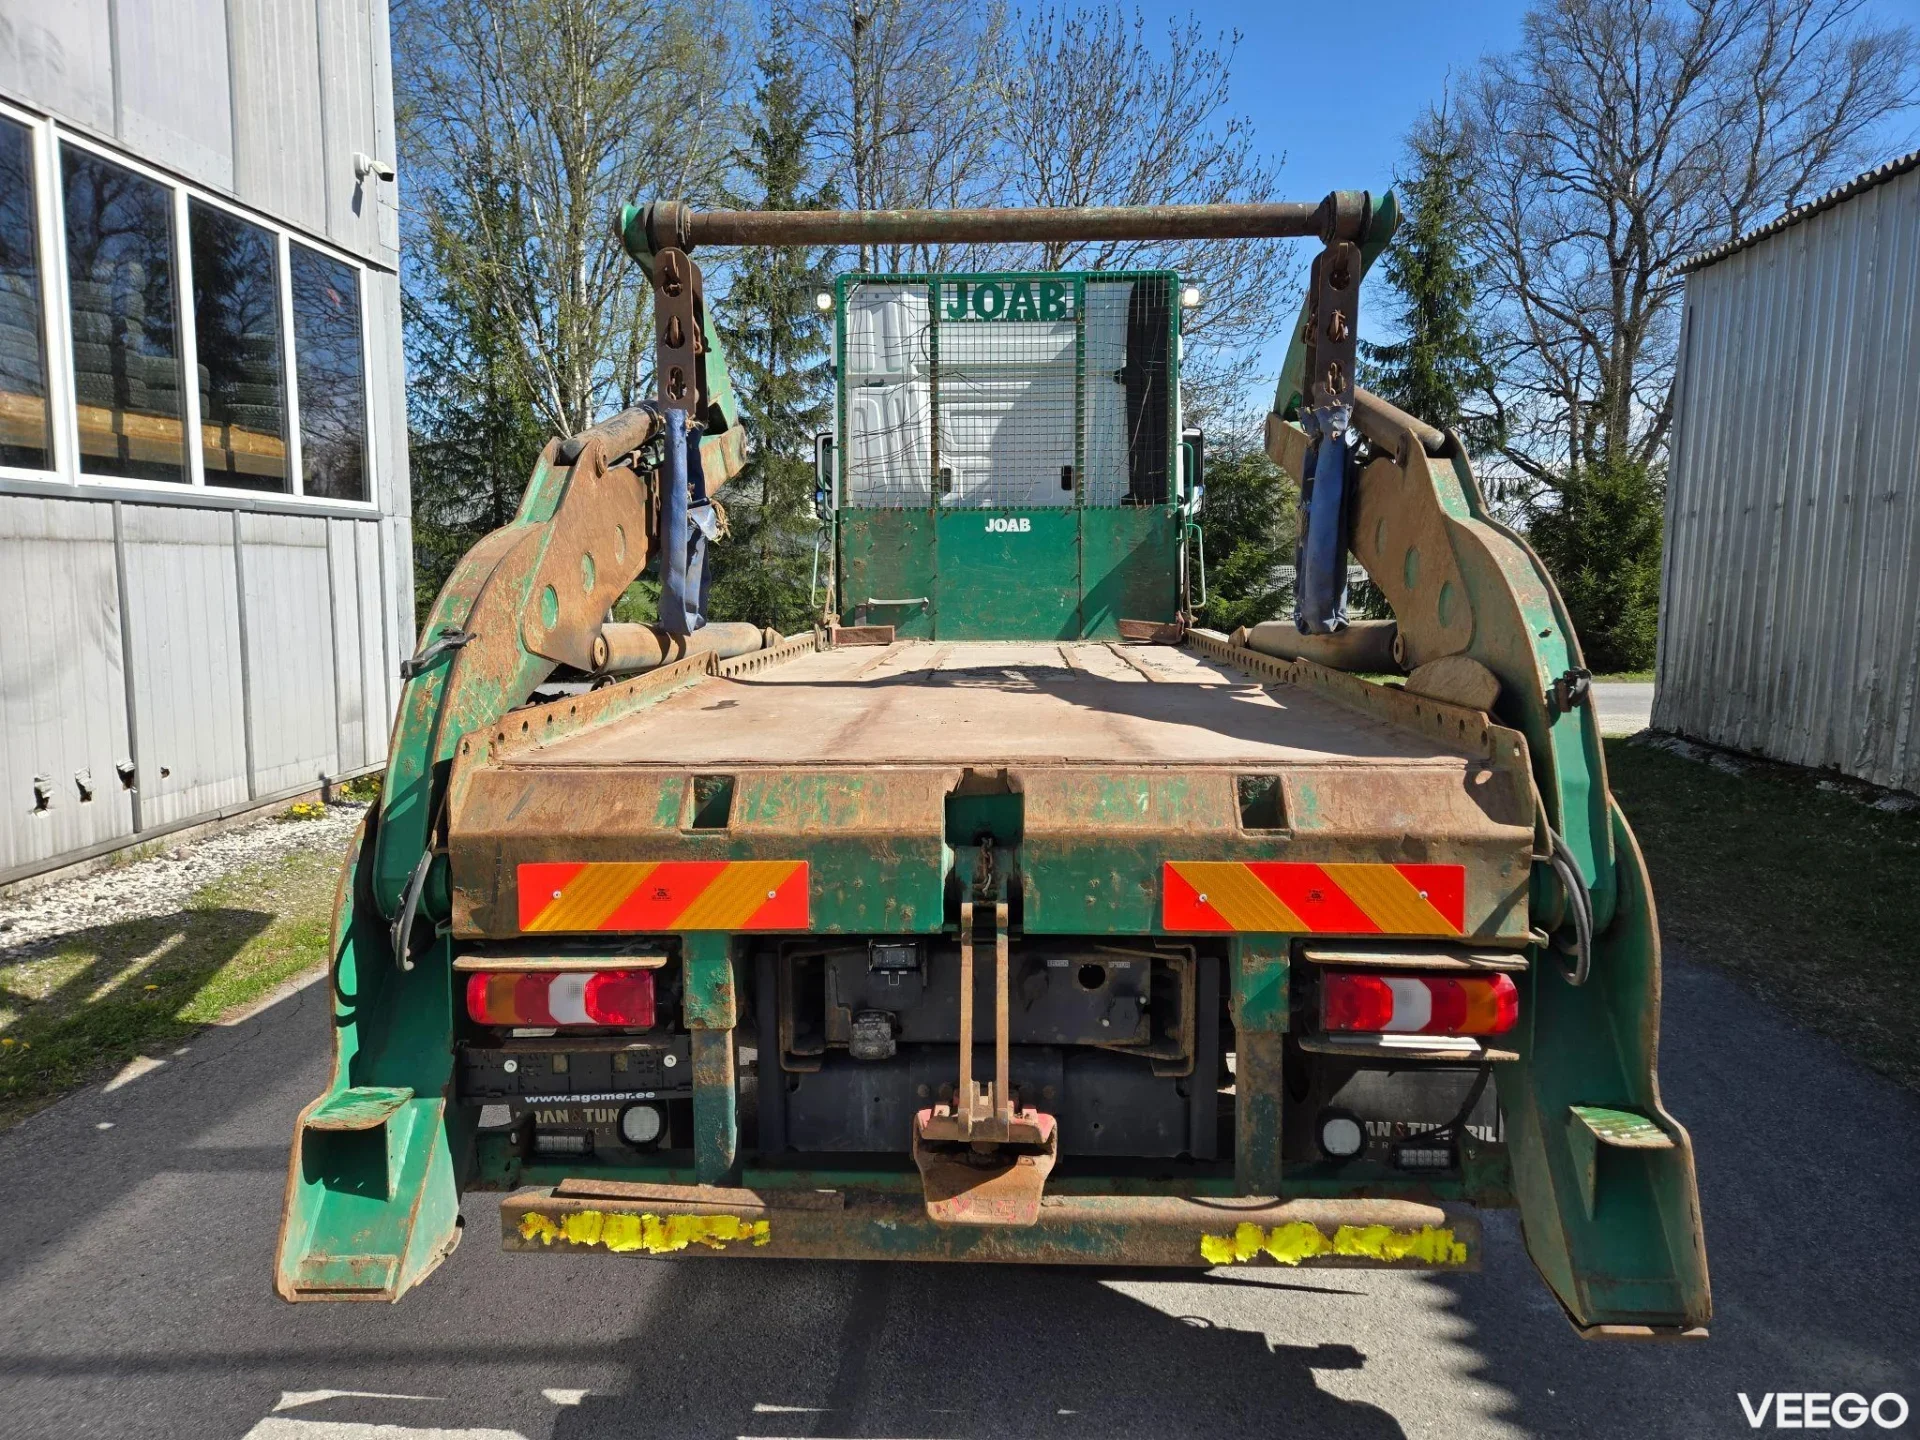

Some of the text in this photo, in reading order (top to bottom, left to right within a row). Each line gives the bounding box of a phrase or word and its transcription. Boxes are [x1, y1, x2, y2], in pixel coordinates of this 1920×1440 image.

[947, 281, 1066, 320] JOAB
[985, 517, 1031, 533] JOAB
[524, 1092, 656, 1103] www.agomer.ee
